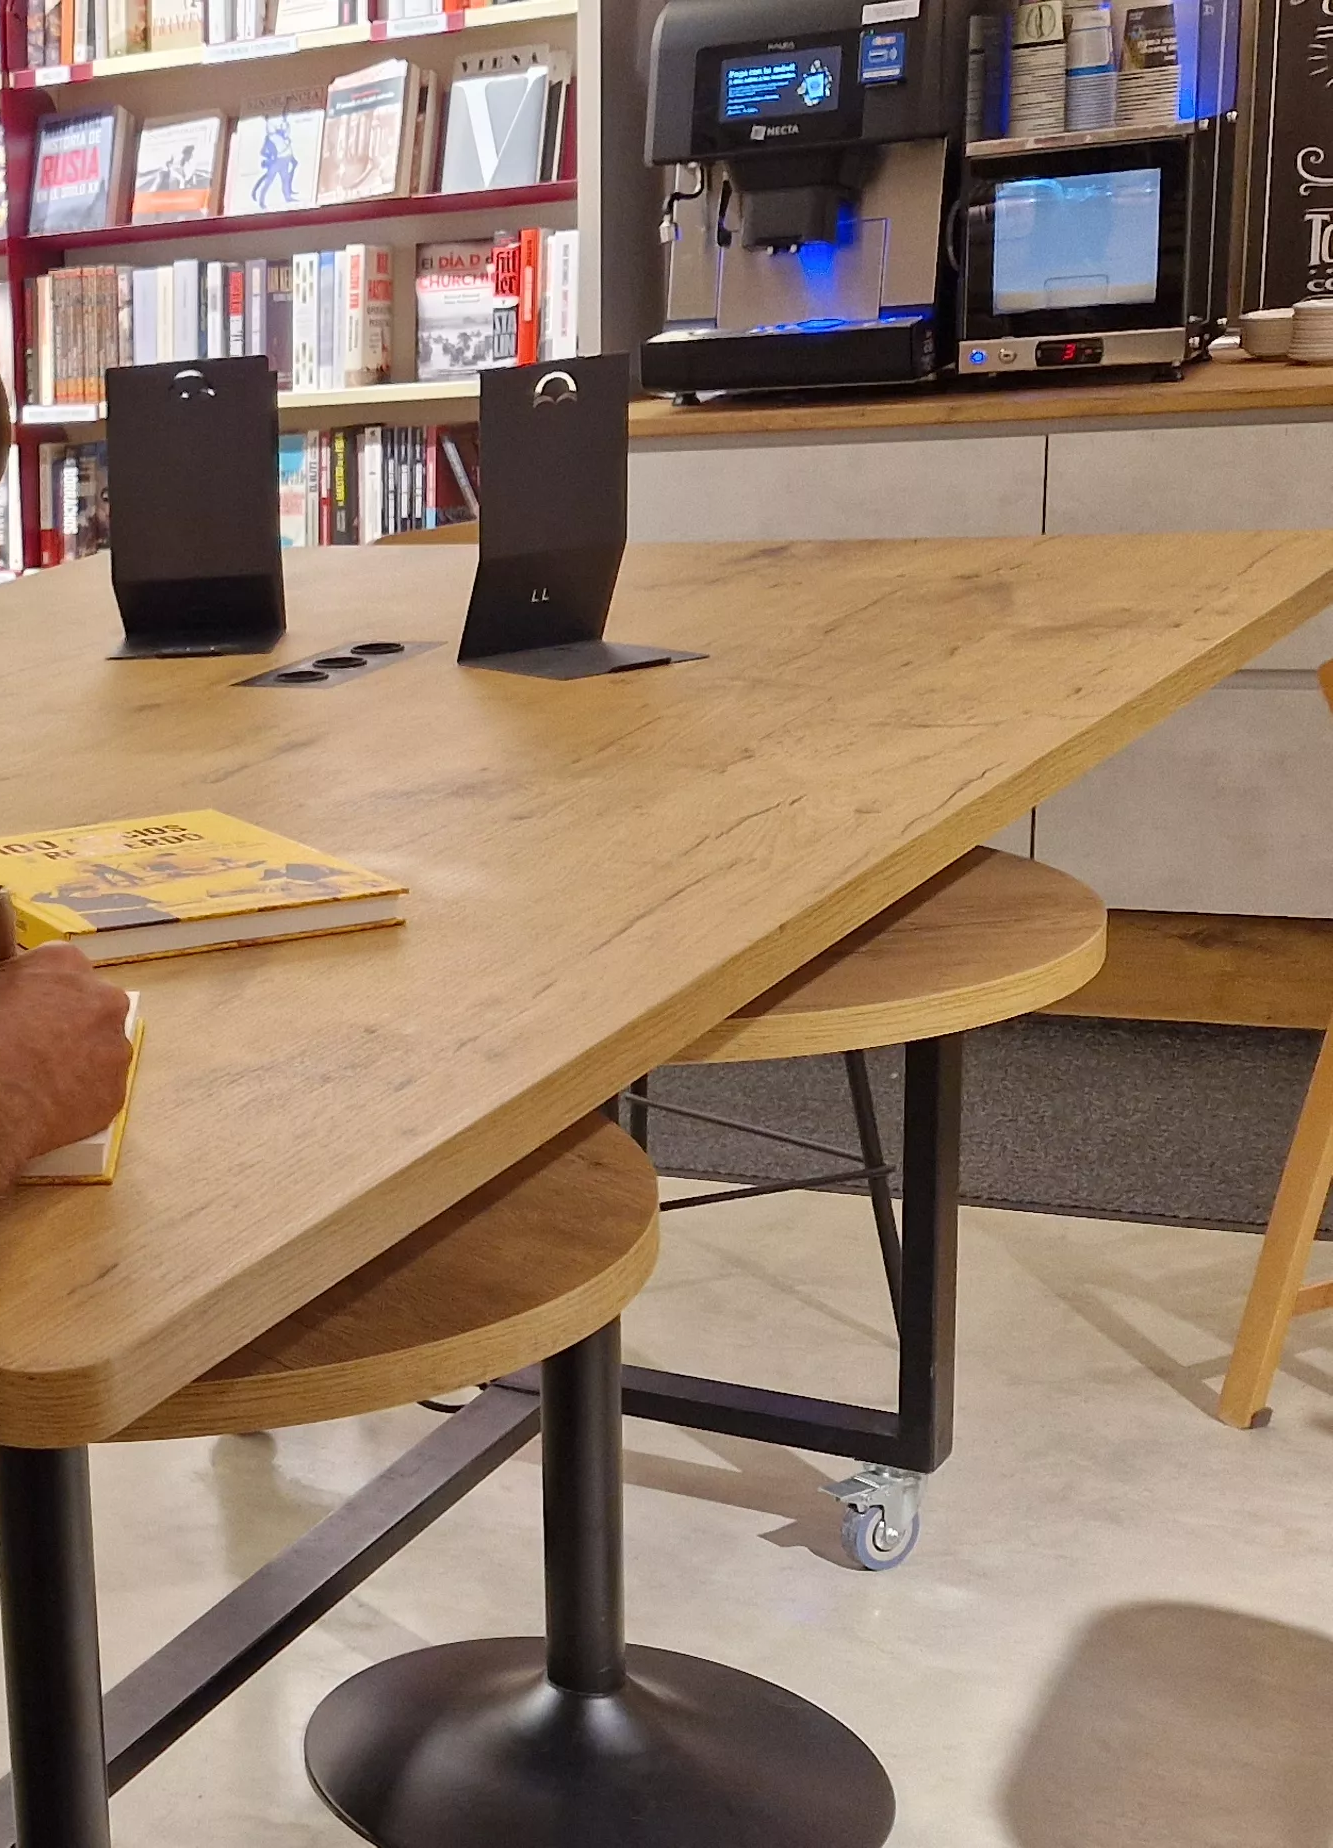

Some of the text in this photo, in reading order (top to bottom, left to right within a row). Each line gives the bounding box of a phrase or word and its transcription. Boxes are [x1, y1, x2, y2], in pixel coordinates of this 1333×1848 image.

[461, 52, 539, 73] VIENA
[766, 124, 799, 137] NECTA
[40, 147, 100, 189] RUSIA
[438, 252, 465, 269] DÍA
[470, 254, 481, 266] D
[1062, 343, 1076, 361] 3
[44, 832, 205, 861] REERDO
